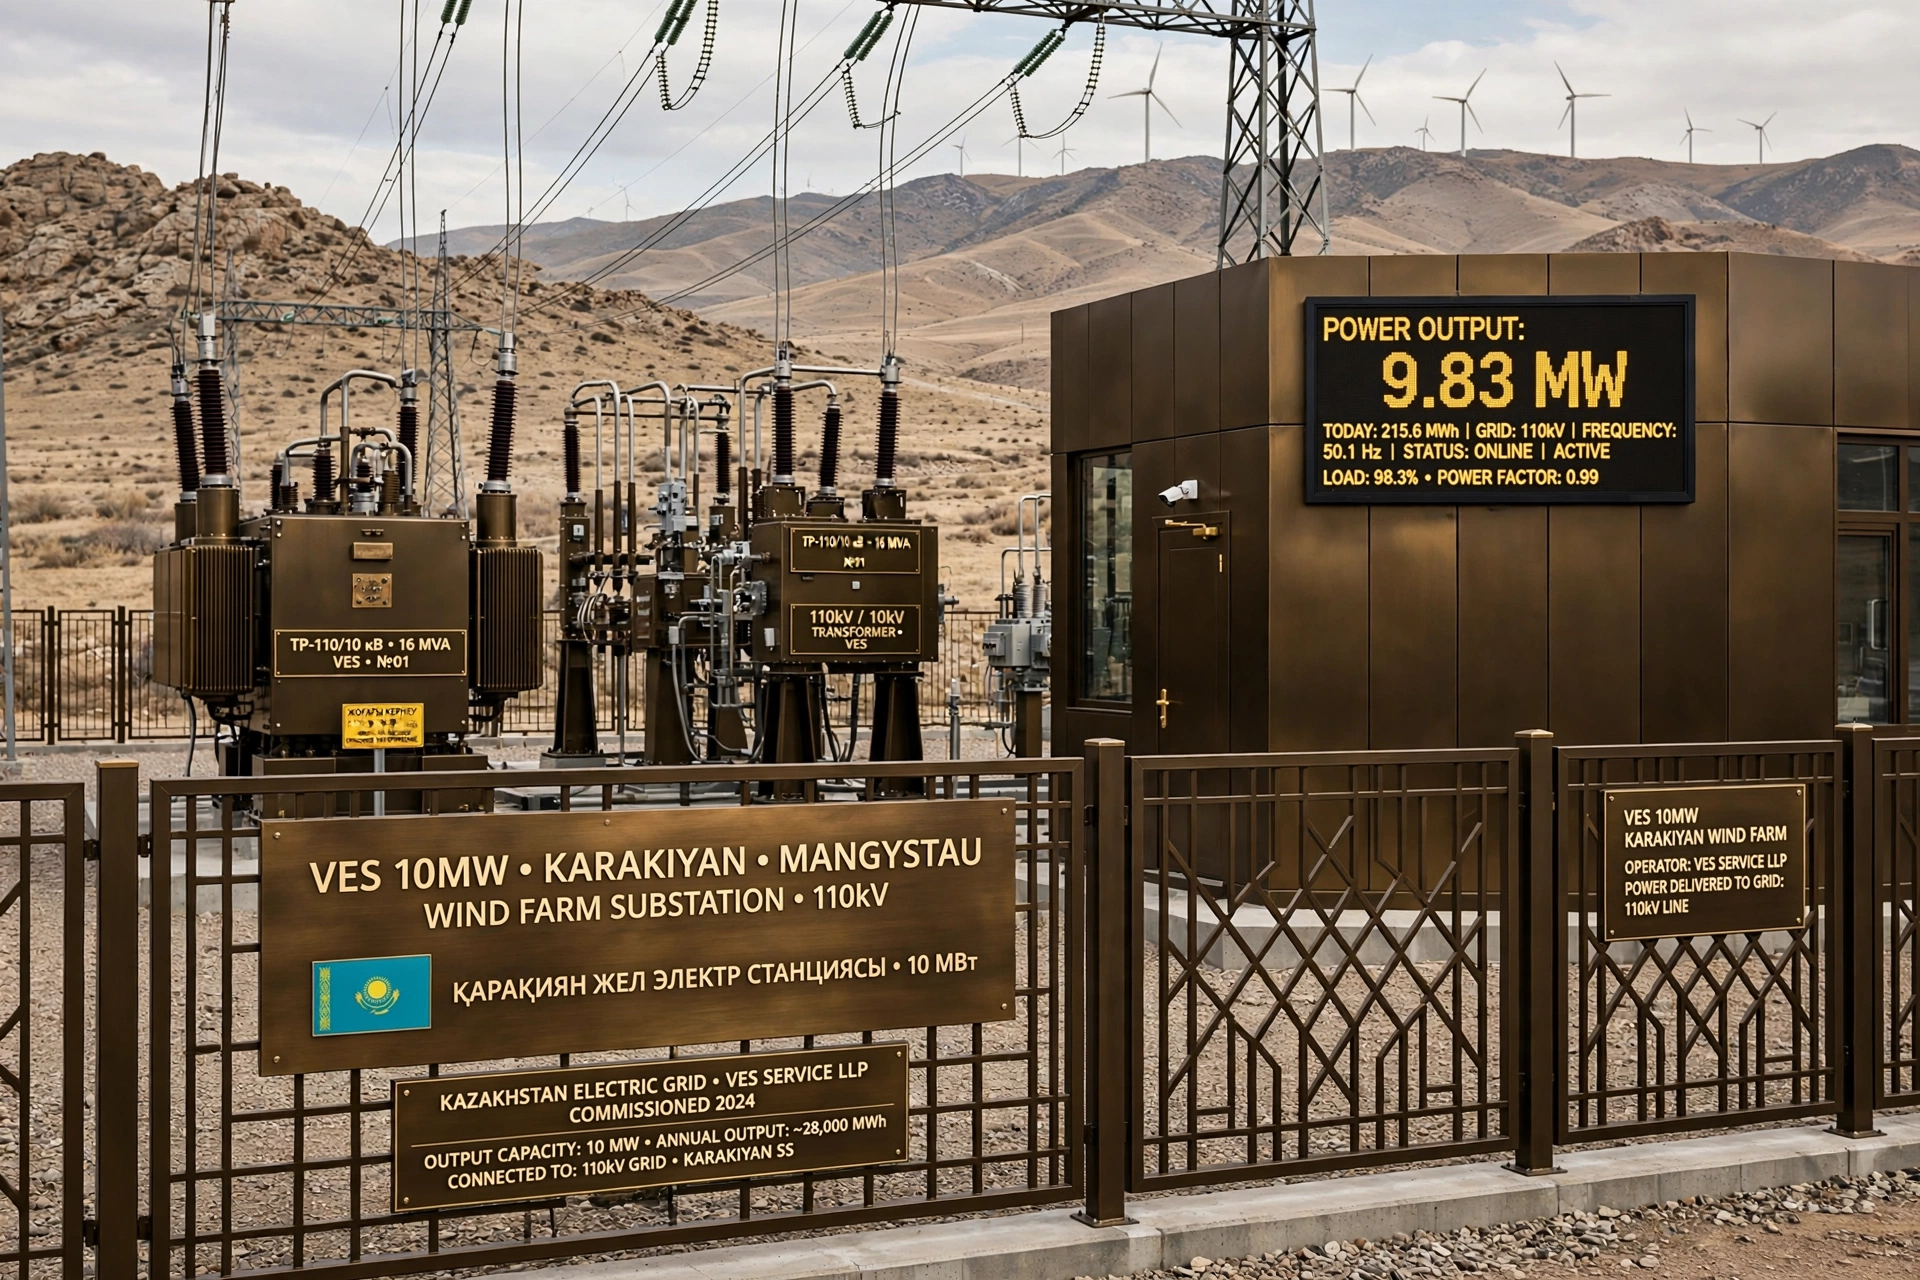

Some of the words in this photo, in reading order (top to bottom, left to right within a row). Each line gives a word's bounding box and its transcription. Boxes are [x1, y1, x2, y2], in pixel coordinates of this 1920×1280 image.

[1324, 317, 1411, 341] POWER
[1419, 316, 1524, 340] OUTPUT:
[1383, 352, 1513, 408] 9.83
[1536, 351, 1627, 408] MW
[1323, 423, 1377, 438] TODAY:
[1382, 423, 1422, 438] 215.6
[1426, 423, 1459, 438] MWh
[1476, 423, 1515, 438] GRID:
[1521, 423, 1565, 438] 110kV
[1583, 423, 1676, 438] FREQUENCY:
[1323, 444, 1354, 459] 50.1
[1362, 444, 1382, 459] Hz
[1404, 443, 1468, 459] STATUS:
[1474, 443, 1533, 459] ONLINE
[1554, 443, 1610, 459] ACTIVE
[1324, 470, 1369, 485] LOAD:
[1374, 469, 1418, 485] 98.3%
[1438, 469, 1492, 485] POWER
[1498, 469, 1561, 485] FACTOR:
[1566, 469, 1598, 484] 0.99
[811, 610, 853, 624] 110kV
[870, 610, 904, 624] 10kV
[812, 626, 895, 637] TRANSFORMER
[400, 638, 415, 650] 16
[419, 638, 451, 650] MVA
[845, 639, 867, 649] VES
[333, 656, 360, 668] VES
[1624, 809, 1650, 825] VES
[1656, 807, 1698, 824] 10MW
[1625, 829, 1703, 848] KARAKIYAN
[1708, 828, 1746, 844] WIND
[1751, 826, 1786, 842] FARM
[309, 860, 381, 893] VES
[395, 855, 508, 889] 10MW
[546, 846, 745, 882] KARAKIYAN
[781, 838, 981, 873] MANGYSTAU
[1625, 858, 1691, 874] OPERATOR:
[1694, 857, 1715, 871] VES
[1719, 855, 1764, 870] SERVICE
[1768, 853, 1787, 868] LLP
[1625, 880, 1667, 896] POWER
[1670, 877, 1732, 893] DELIVERED
[1734, 876, 1750, 889] TO
[1753, 874, 1784, 888] GRID:
[424, 900, 509, 928] WIND
[521, 896, 600, 924] FARM
[611, 887, 783, 919] SUBSTATION
[814, 882, 889, 909] 110kV
[1625, 901, 1660, 915] 110kV
[1663, 899, 1688, 913] LINE
[454, 975, 585, 1007] ҚАРАҚИЯН
[593, 971, 645, 994] ЖЕЛ
[654, 966, 740, 990] ЭЛЕКТР
[748, 957, 885, 985] СТАНЦИЯСЫ
[908, 955, 929, 974] 10
[441, 1085, 567, 1111] KAZAKHSTAN
[575, 1078, 657, 1100] ELECTRIC
[663, 1075, 706, 1092] GRID
[726, 1070, 758, 1087] VES
[764, 1064, 832, 1085] SERVICE
[839, 1062, 868, 1078] LLP
[569, 1096, 711, 1125] COMMISSIONED
[716, 1093, 755, 1110] 2024
[425, 1150, 493, 1169] OUTPUT
[498, 1142, 580, 1162] CAPACITY:
[587, 1140, 604, 1154] 10
[610, 1136, 639, 1152] MW
[656, 1130, 720, 1148] ANNUAL
[725, 1124, 789, 1142] OUTPUT:
[793, 1118, 848, 1136] ~28,000
[853, 1114, 886, 1130] MWh
[448, 1167, 546, 1189] CONNECTED
[550, 1164, 576, 1178] TO:
[583, 1159, 625, 1175] 110kV
[629, 1155, 666, 1171] GRID
[684, 1145, 771, 1166] KARAKIYAN
[777, 1143, 794, 1157] SS
